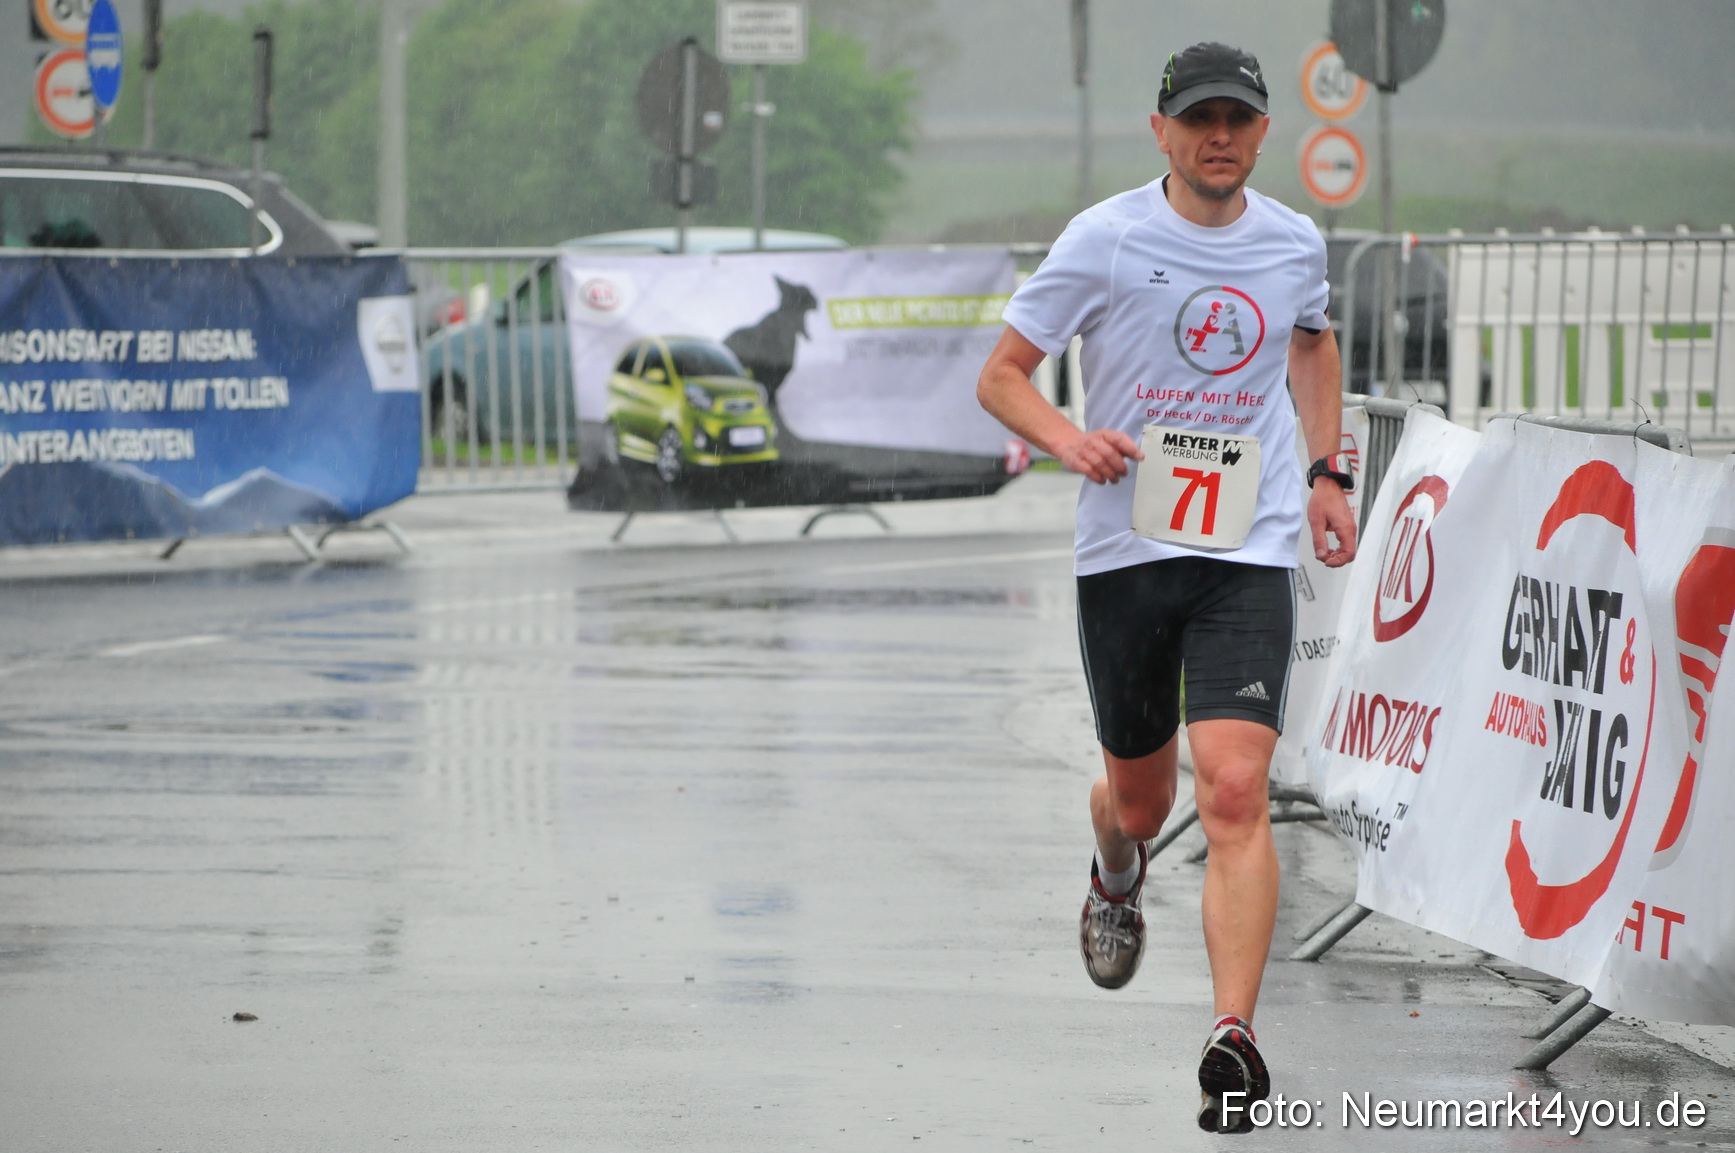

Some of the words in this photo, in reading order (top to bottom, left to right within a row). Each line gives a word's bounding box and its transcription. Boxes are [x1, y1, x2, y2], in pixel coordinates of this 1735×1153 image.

[136, 329, 174, 363] BEI
[1164, 408, 1192, 420] Heck
[1162, 433, 1219, 451] MEYER
[1162, 446, 1218, 462] WERBUNG
[1169, 467, 1221, 536] 71
[1619, 617, 1636, 685] &
[1235, 690, 1270, 701] adidas
[1339, 690, 1442, 774] MOTORS
[1485, 691, 1547, 747] AUTOHAUS
